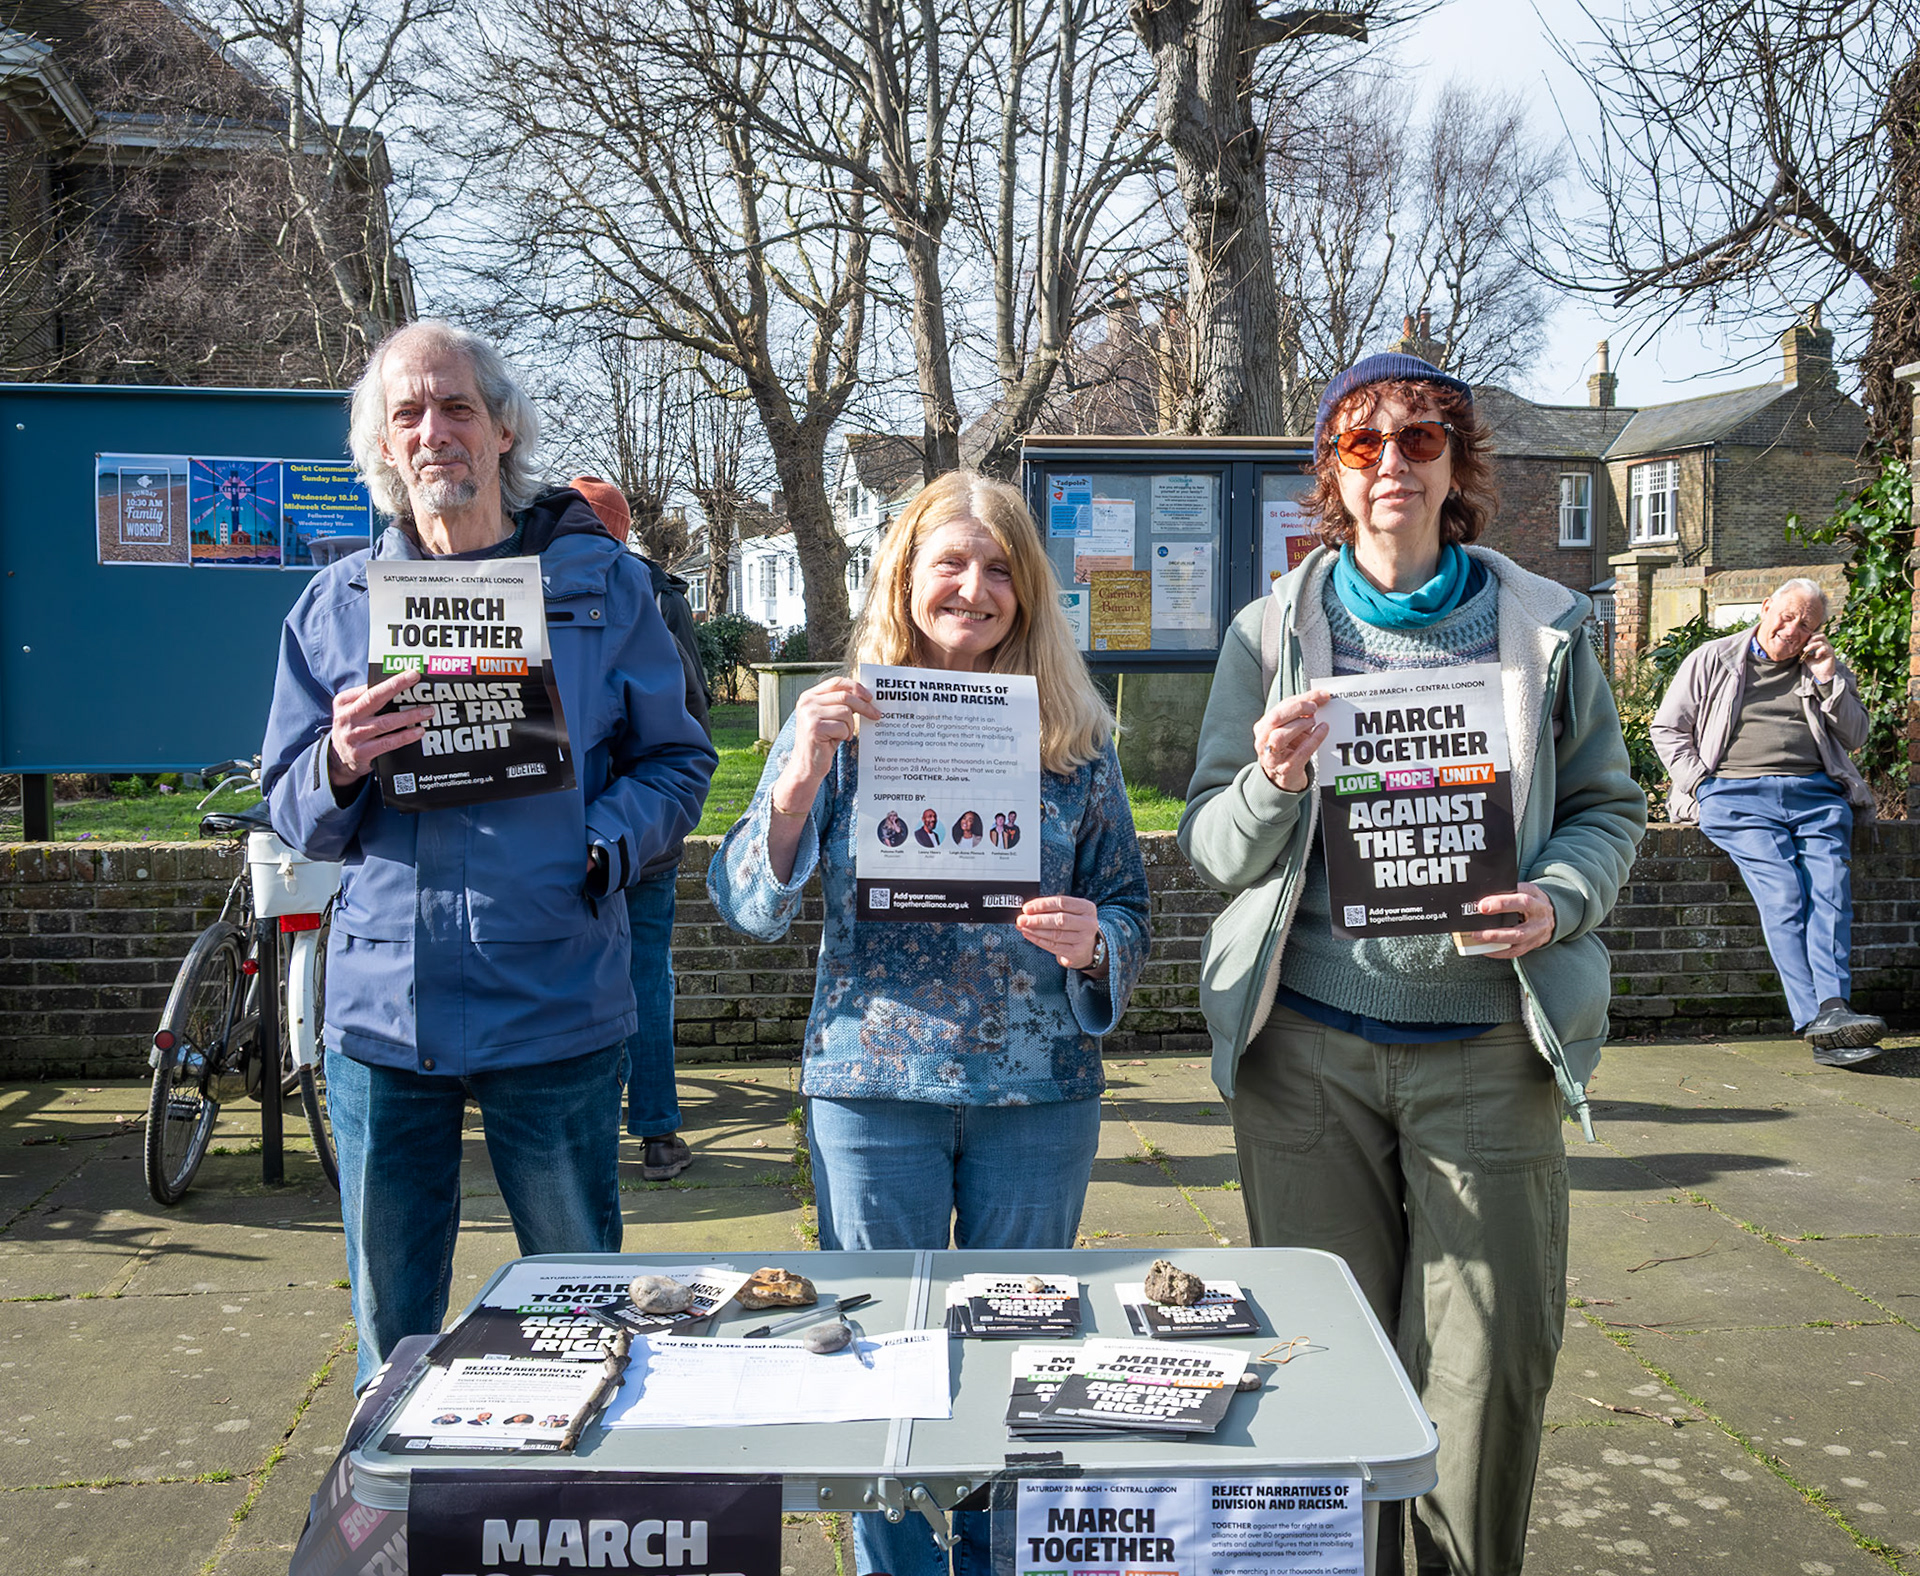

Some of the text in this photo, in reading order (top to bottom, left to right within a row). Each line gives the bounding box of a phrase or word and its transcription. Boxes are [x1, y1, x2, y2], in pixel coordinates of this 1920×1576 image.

[302, 475, 330, 483] Sunday
[292, 494, 337, 502] Wednesday
[124, 506, 164, 523] Family
[126, 522, 164, 537] WORSHIP
[1296, 538, 1312, 547] The
[406, 597, 505, 621] MARCH
[1102, 601, 1140, 612] Burana
[388, 624, 523, 649] TOGETHER
[386, 657, 524, 673] LOVE HOPE UNITY
[876, 678, 1009, 694] REJECT NARRATIVES OF
[1380, 687, 1407, 695] MARCH
[1416, 684, 1450, 692] CENTRAL
[1452, 680, 1484, 689] LONDON
[876, 691, 1008, 706] DIVISION AND RACISM.
[465, 700, 526, 723] FAR
[1355, 704, 1466, 737] MARCH
[421, 723, 512, 757] RIGHT
[1336, 731, 1489, 766] TOGETHER
[506, 762, 548, 778] TOGETHER
[419, 775, 433, 783] Add
[433, 774, 448, 782] your
[419, 776, 494, 790] togetheralliance.org.uk
[1339, 766, 1490, 792] LOVE HOPE UNITY
[1348, 792, 1487, 830] AGAINST
[1353, 824, 1486, 859] THE FAR
[1373, 855, 1470, 889] RIGHT
[893, 900, 969, 909] togetheralliance.org.uk
[982, 894, 1024, 907] TOGETHER
[1369, 908, 1384, 916] Add
[1370, 912, 1447, 924] togetheralliance.org.uk
[556, 1284, 630, 1293] MAR
[690, 1282, 725, 1297] MARCH
[521, 1327, 593, 1338] THE
[1116, 1354, 1212, 1368] MARCH
[1096, 1363, 1224, 1378] TOGETHER
[1086, 1381, 1212, 1399] AGAINST
[1131, 1377, 1170, 1385] HOPE
[1177, 1380, 1223, 1388] UNITY
[1087, 1390, 1203, 1409] THE FAR
[1093, 1401, 1184, 1416] RIGHT
[1212, 1486, 1349, 1496] REJECT NARRATIVES OF
[1212, 1499, 1348, 1510] DIVISION AND RACISM.
[1047, 1508, 1155, 1533] MARCH
[482, 1519, 708, 1567] MARCH
[1028, 1538, 1175, 1562] TOGETHER
